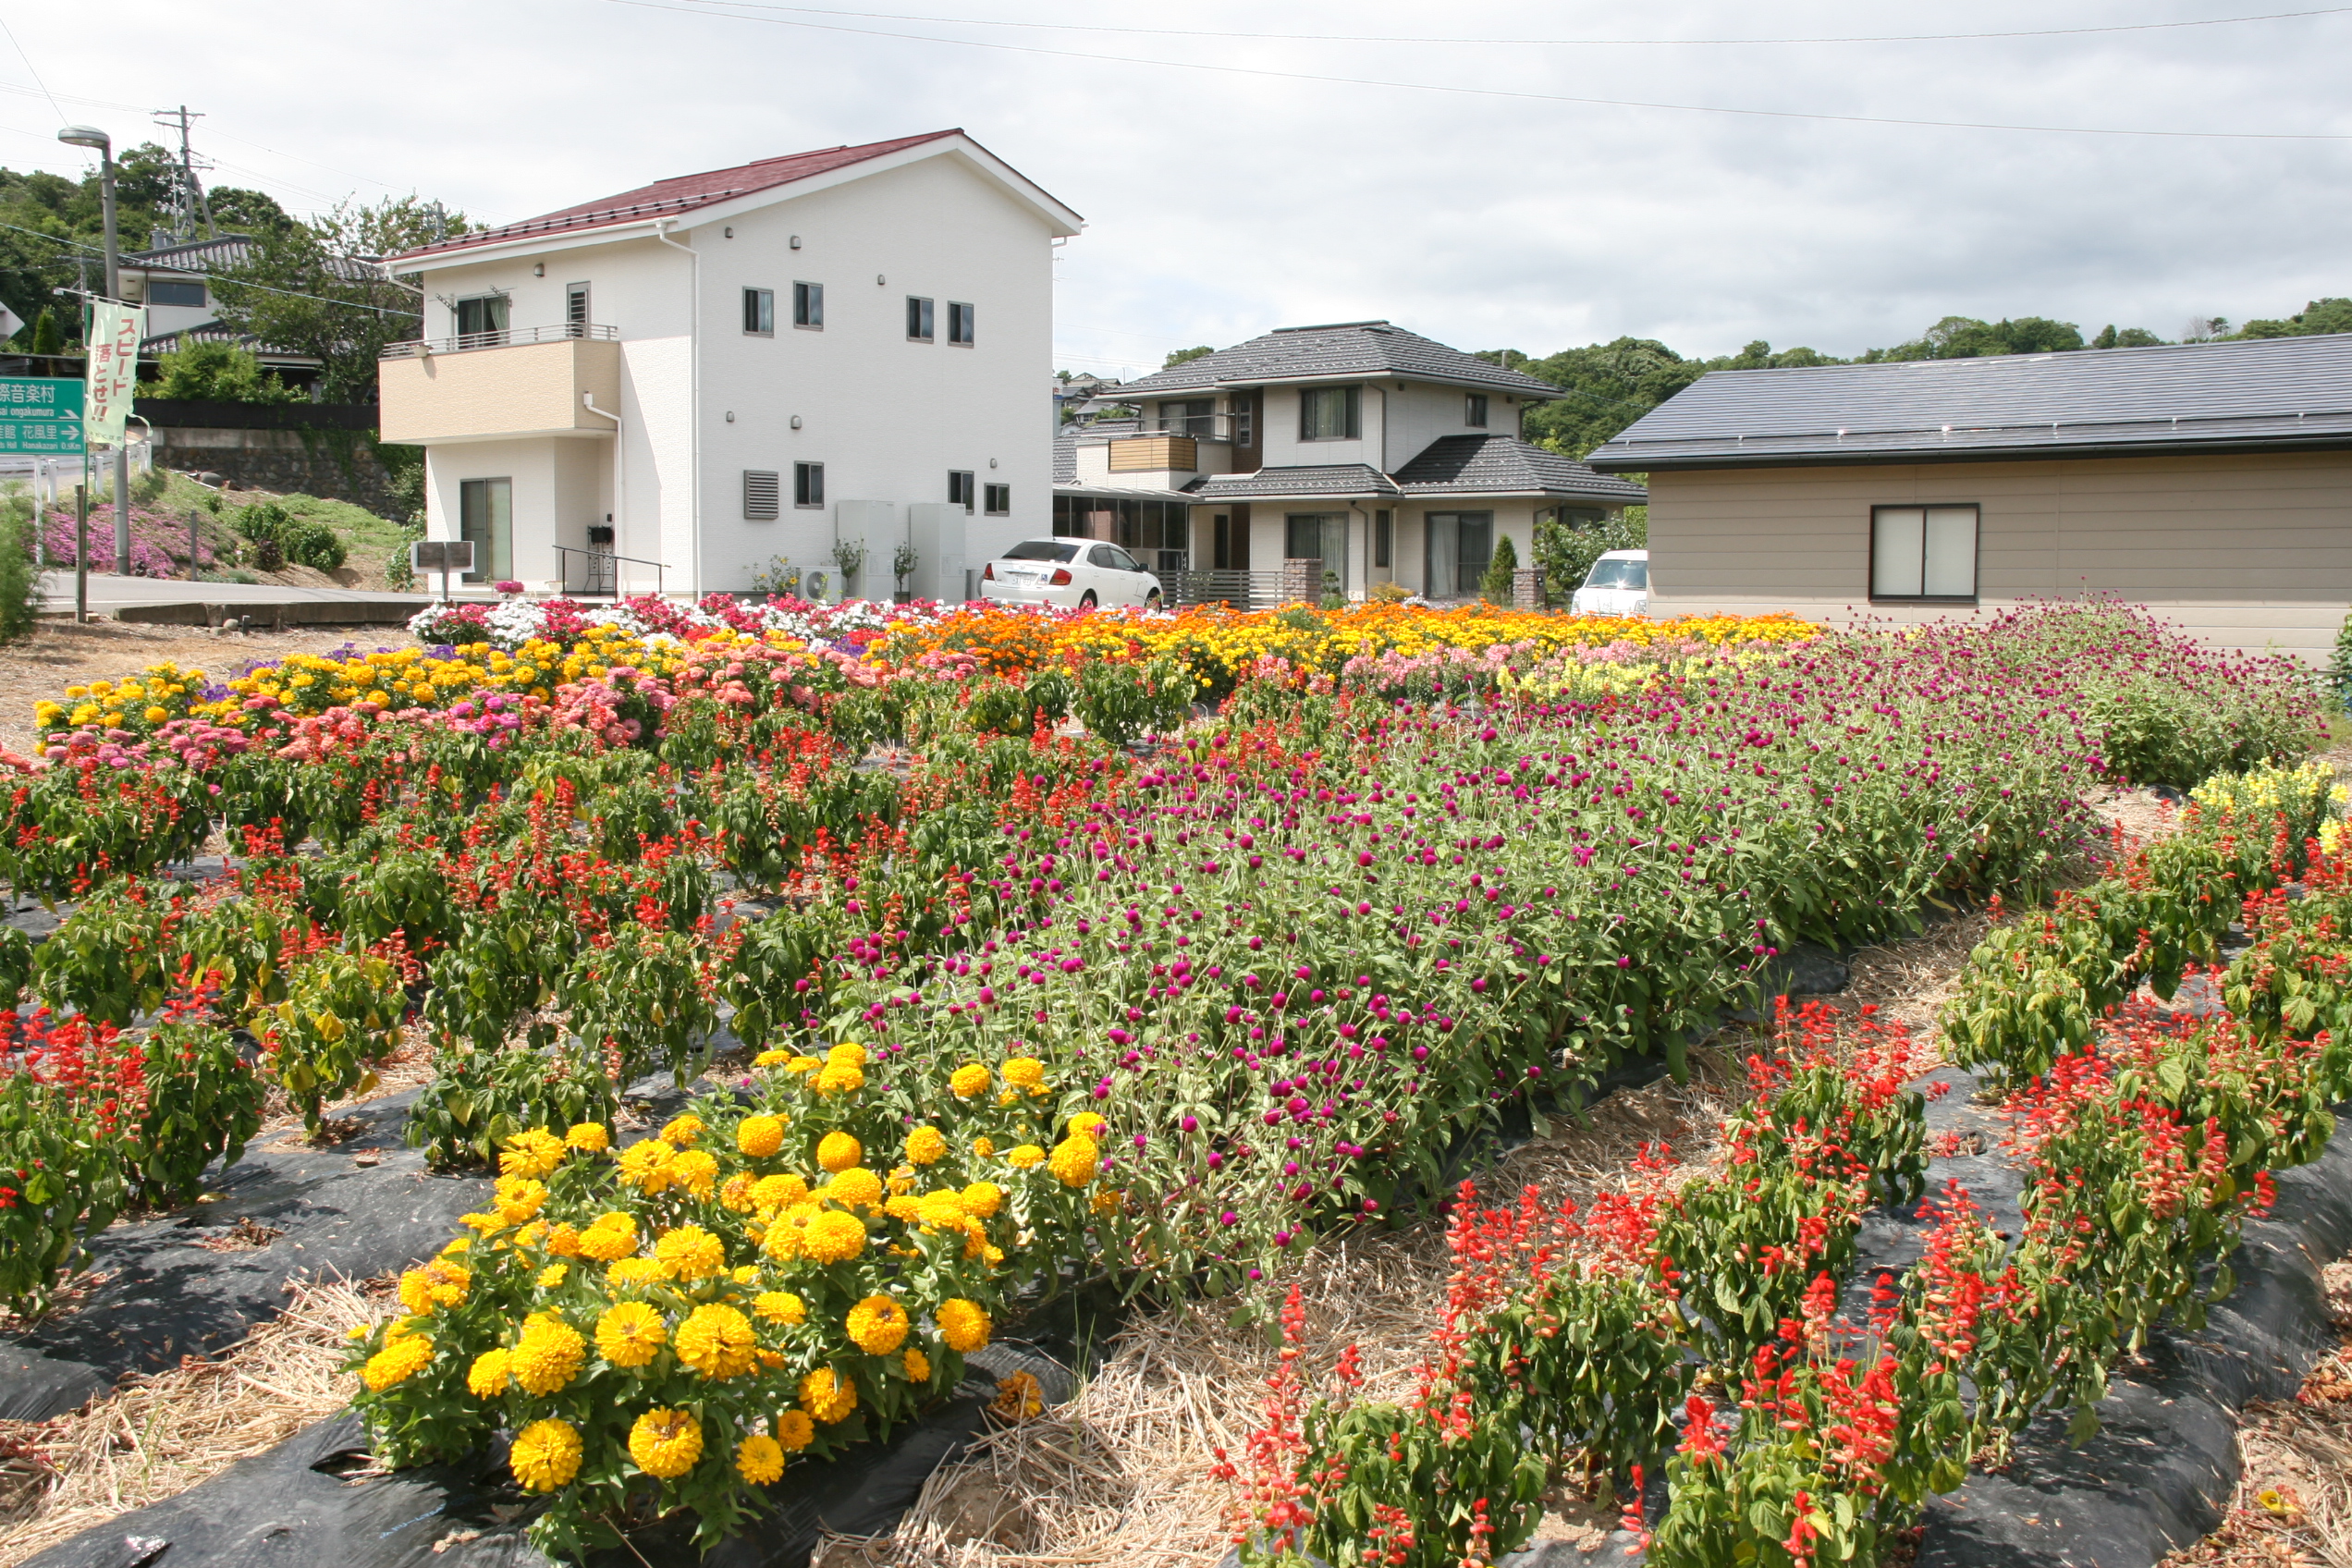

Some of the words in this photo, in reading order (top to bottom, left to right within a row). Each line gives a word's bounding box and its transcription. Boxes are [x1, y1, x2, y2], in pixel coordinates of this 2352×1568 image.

[113, 318, 136, 397] スピード
[10, 406, 55, 418] ongakumura
[21, 424, 57, 439] 花風里
